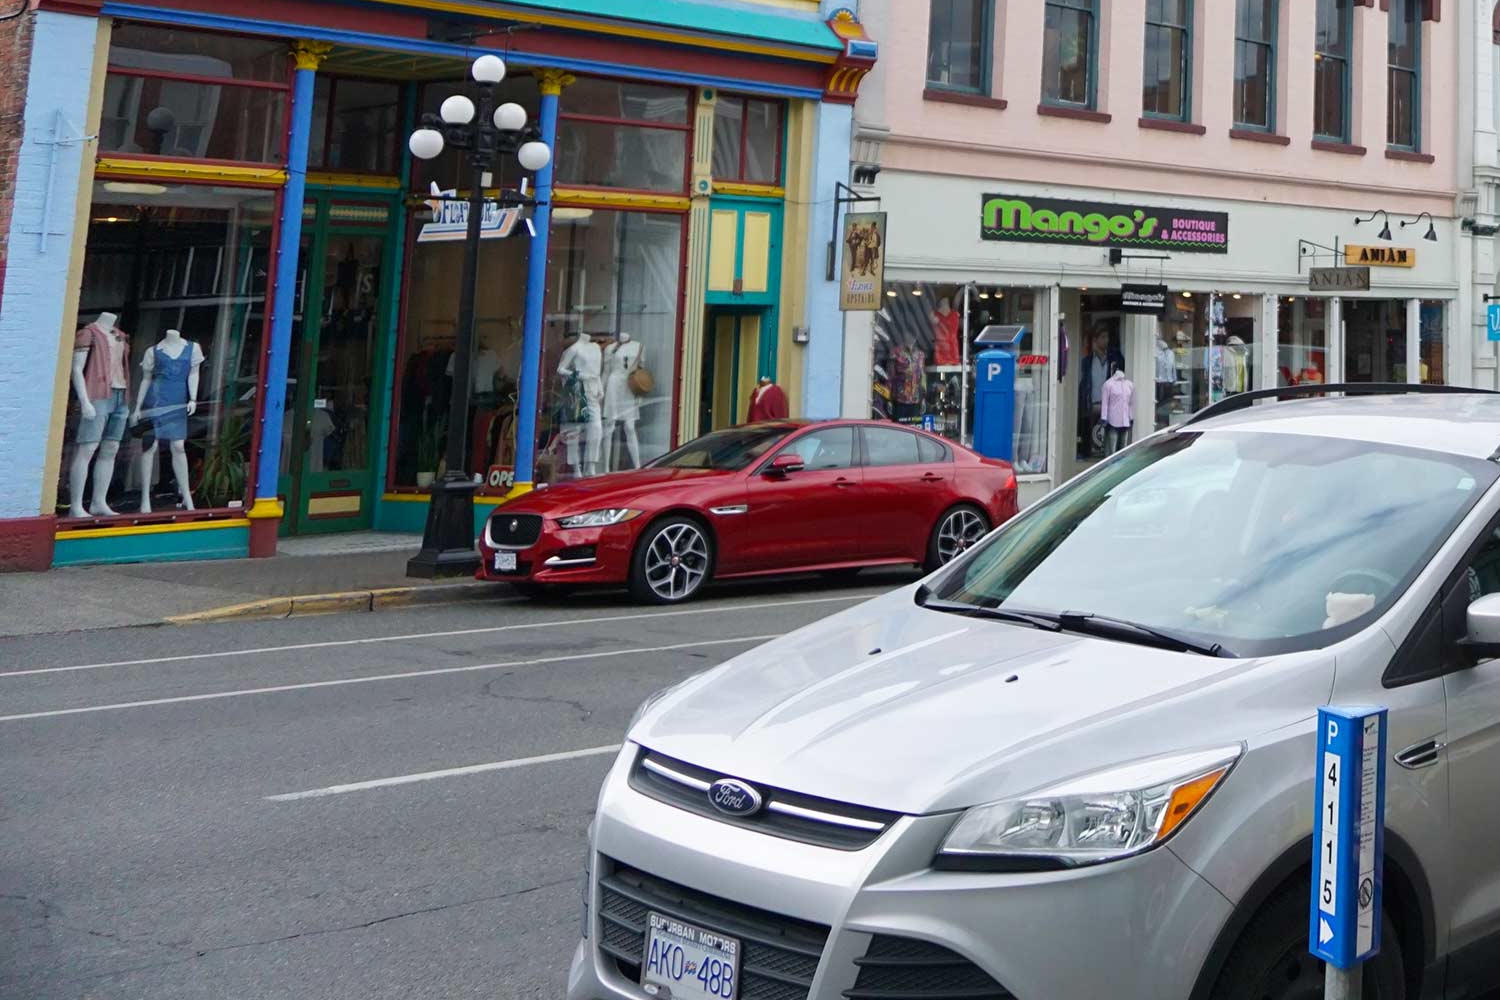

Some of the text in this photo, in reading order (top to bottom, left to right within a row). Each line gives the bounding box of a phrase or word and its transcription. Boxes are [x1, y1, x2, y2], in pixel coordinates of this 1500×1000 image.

[984, 198, 1158, 242] Mango's
[1172, 218, 1216, 232] BOUTIQUE
[1161, 231, 1225, 244] & ACCESSORIES
[1018, 354, 1048, 366] OPEN
[987, 363, 1002, 382] P
[490, 470, 514, 487] OPE
[1327, 720, 1339, 745] P
[715, 781, 745, 810] Ford
[697, 956, 734, 999] 48B
